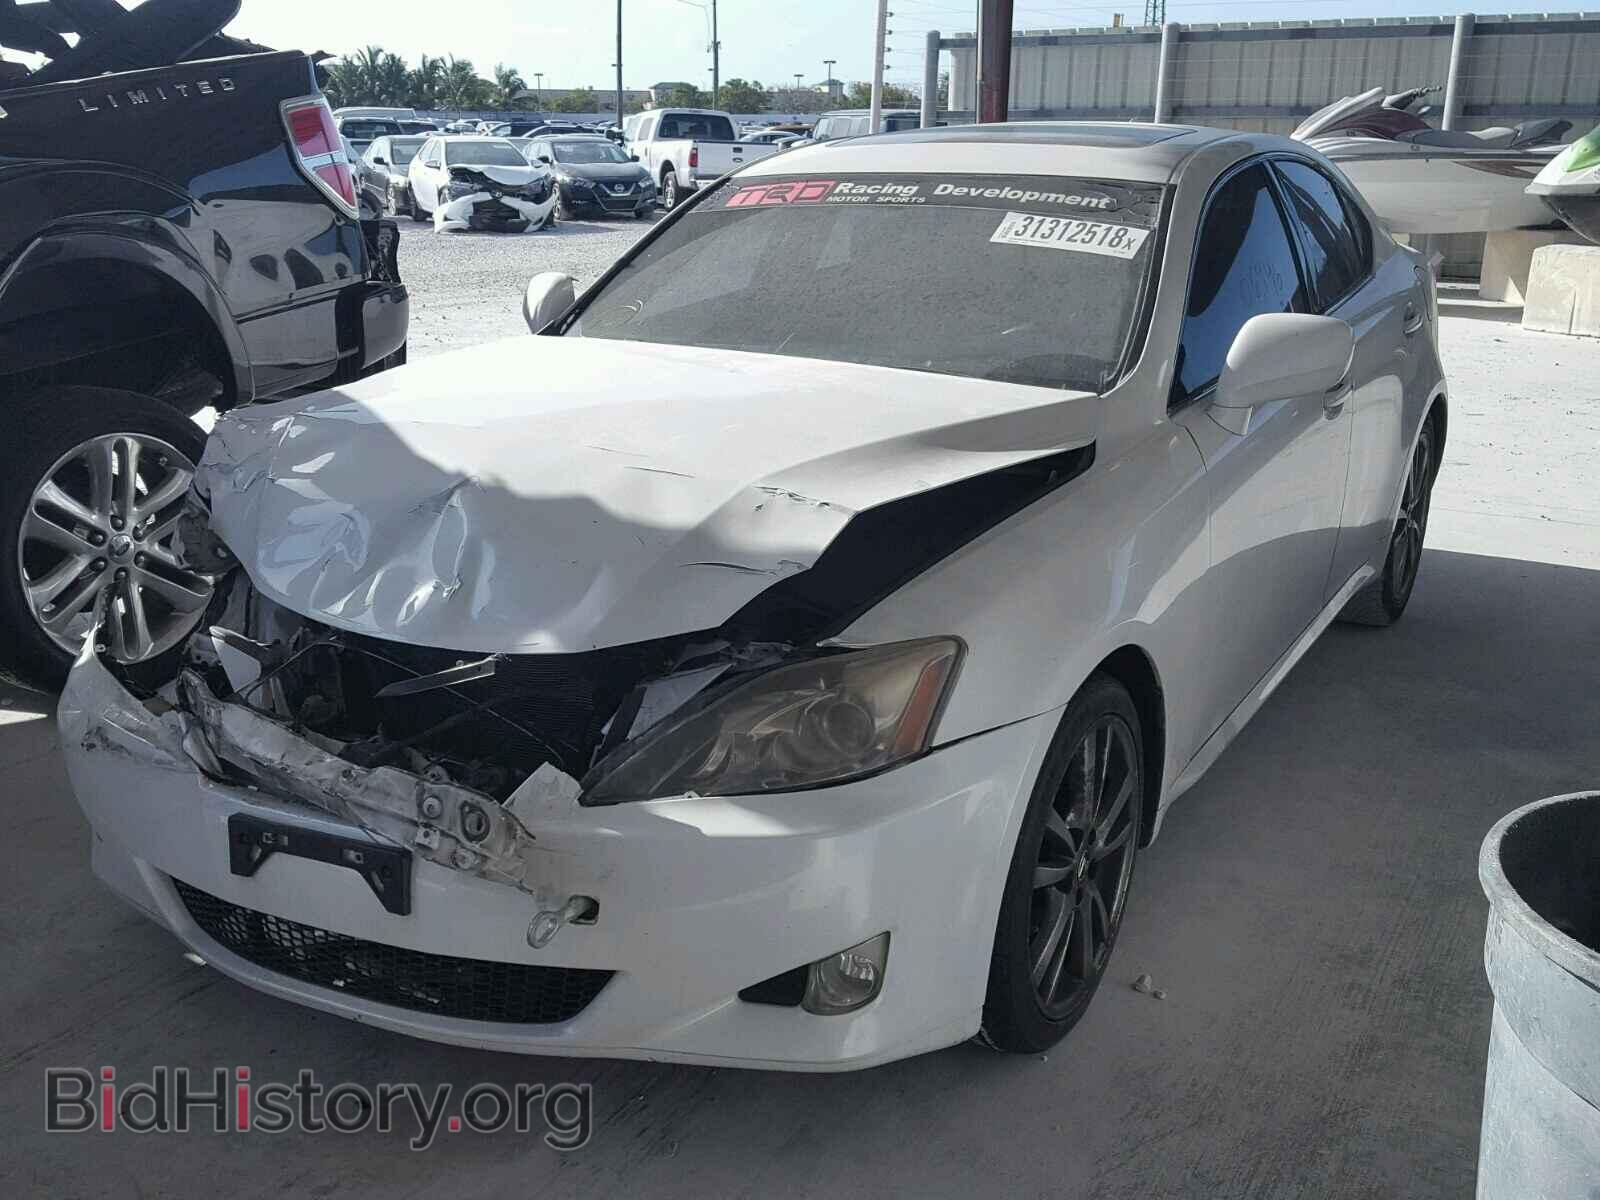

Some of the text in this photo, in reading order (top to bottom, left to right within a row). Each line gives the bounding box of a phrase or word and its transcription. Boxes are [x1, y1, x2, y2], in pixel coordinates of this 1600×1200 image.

[79, 78, 235, 112] LIMITED
[725, 180, 1112, 209] TRD Racing Development
[826, 195, 926, 204] MOTOR SPORTS
